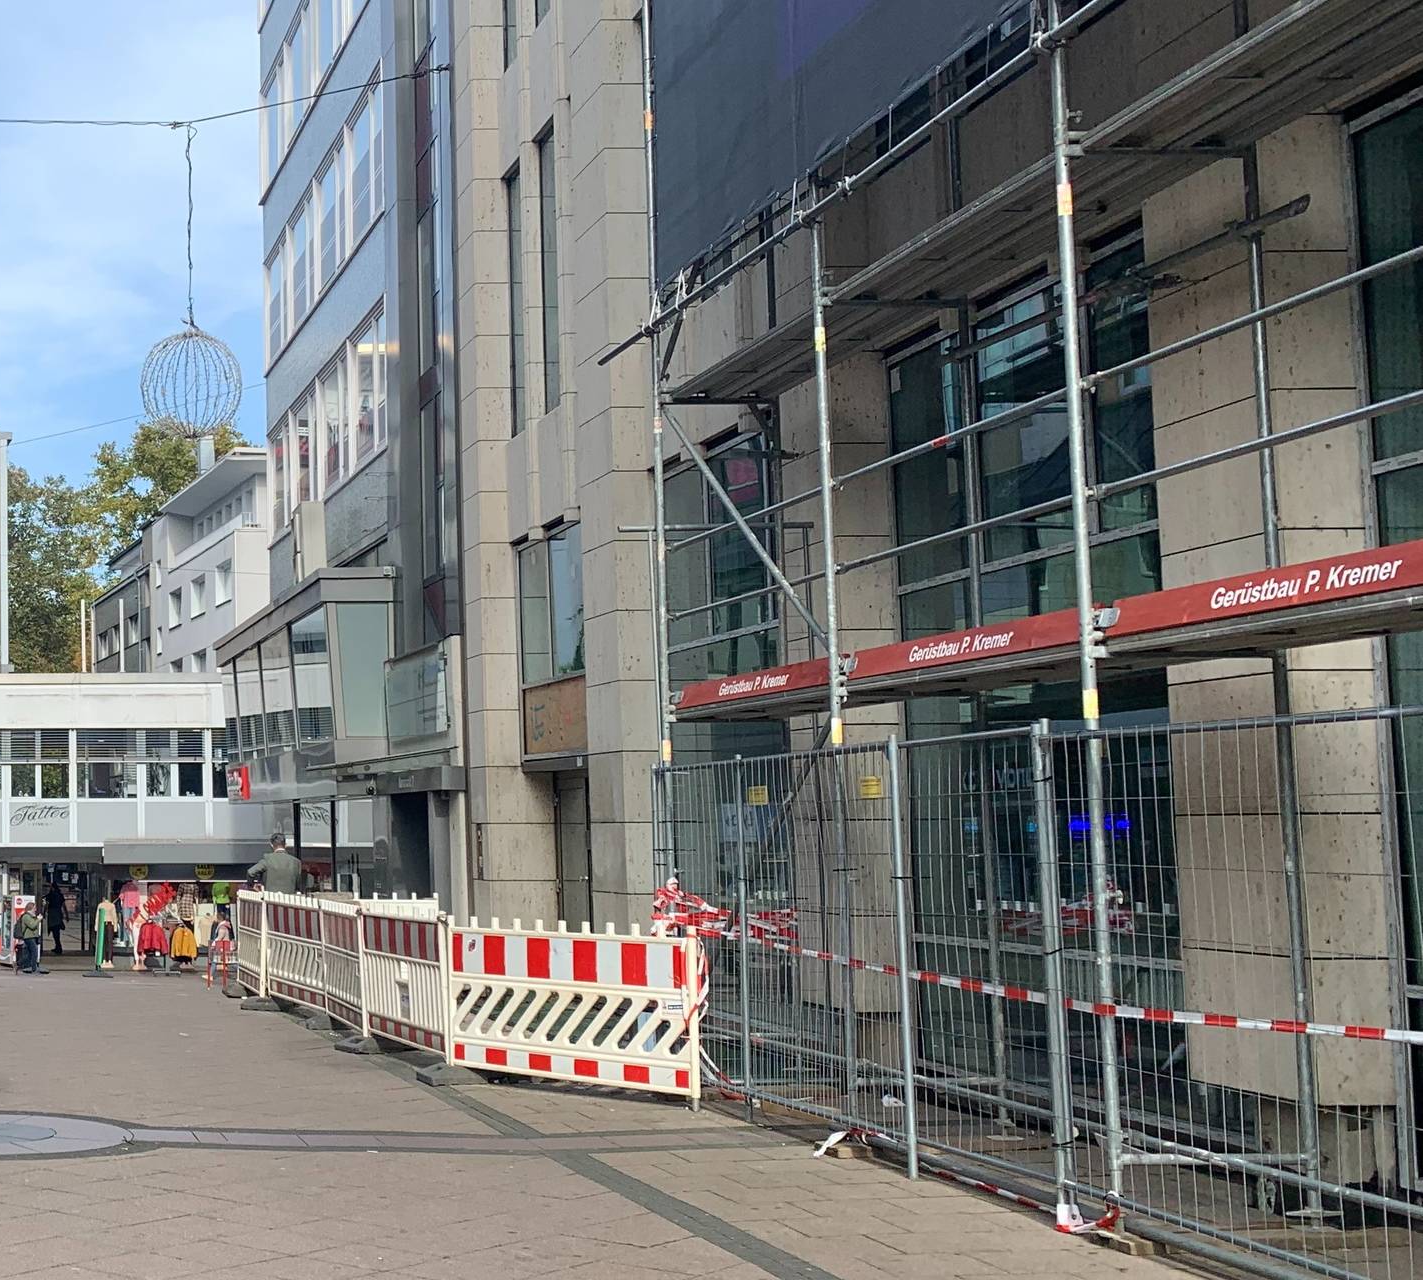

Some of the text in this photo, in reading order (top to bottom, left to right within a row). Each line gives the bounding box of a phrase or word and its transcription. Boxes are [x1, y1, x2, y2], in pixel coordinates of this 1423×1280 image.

[1210, 559, 1403, 609] Gerüstbau P. Kremer
[909, 630, 1014, 663] Gerüstbau P. Kremer
[719, 672, 789, 697] Gerüstbau P. Kremer
[9, 803, 71, 827] Tattoo
